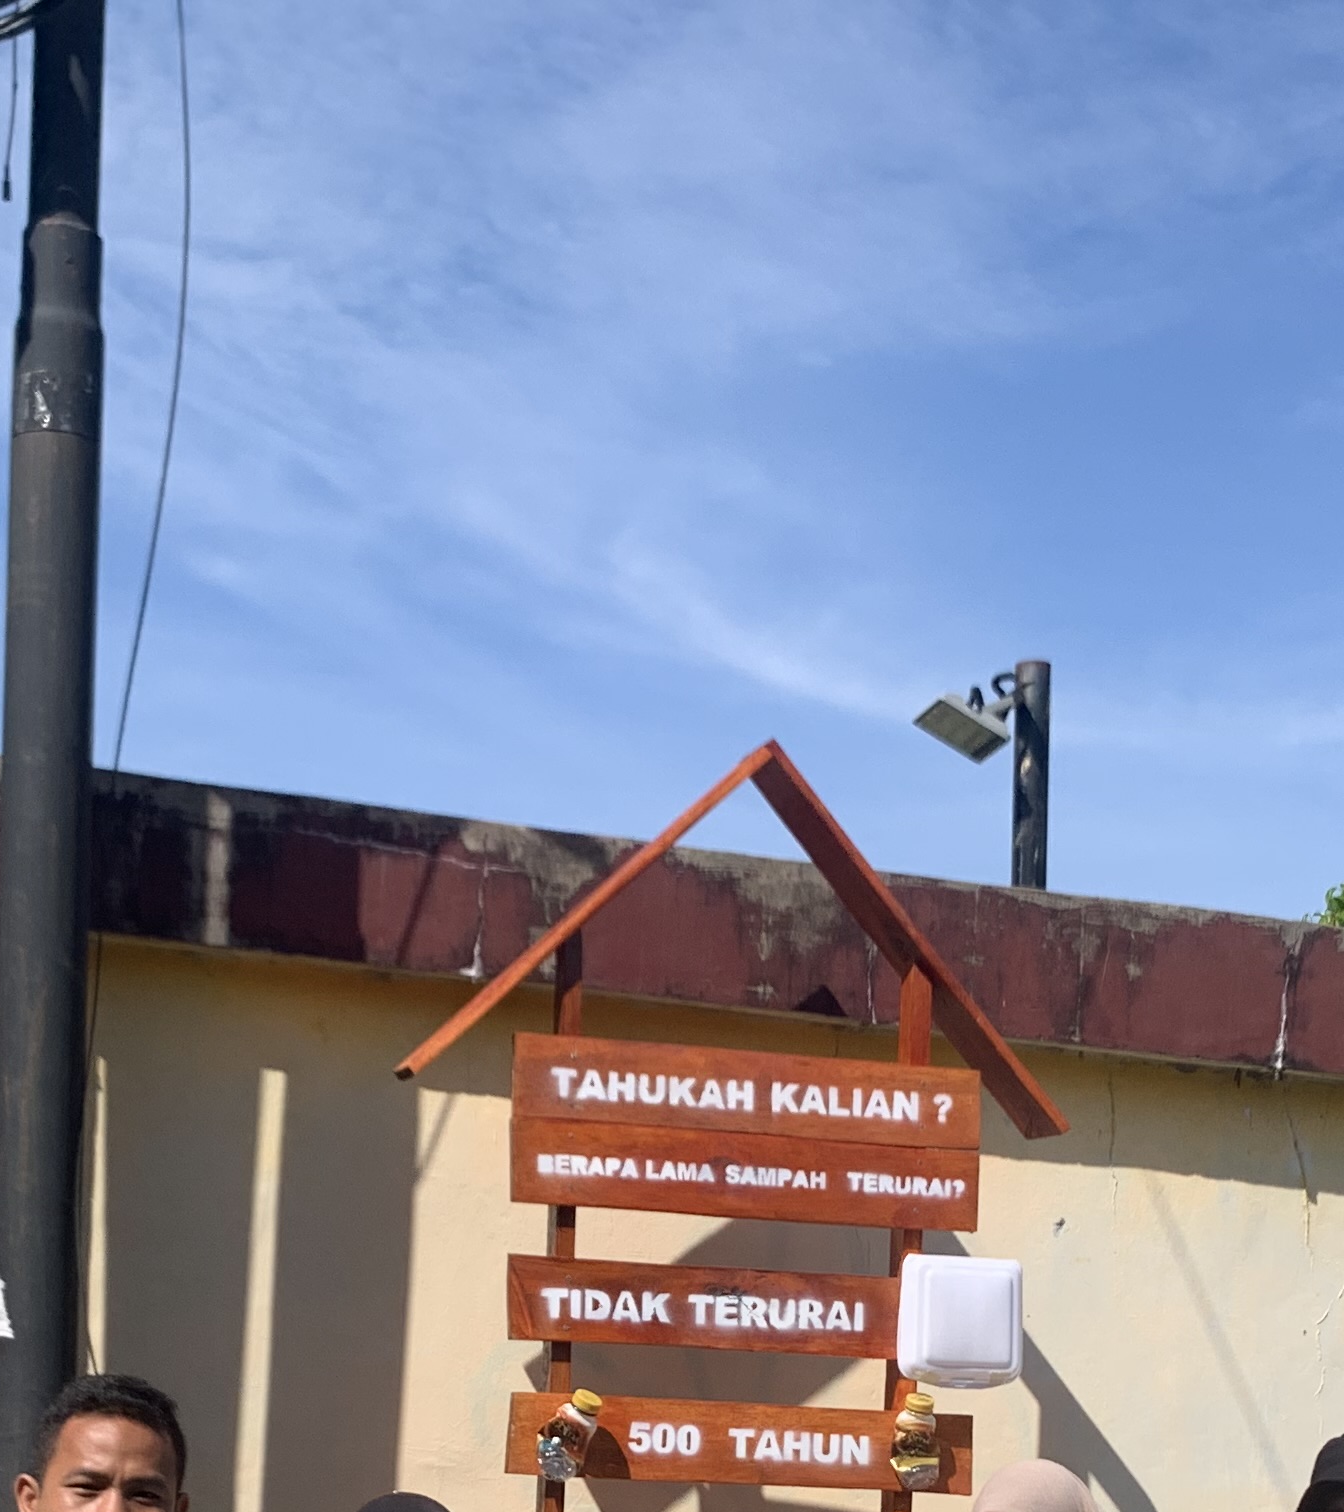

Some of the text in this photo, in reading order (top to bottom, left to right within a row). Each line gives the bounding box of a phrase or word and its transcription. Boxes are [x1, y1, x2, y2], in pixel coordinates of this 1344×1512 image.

[550, 1066, 954, 1124] TAHUKAH KALIAN ?
[536, 1153, 966, 1199] BERAPA LAMA SAMPAH TERURAI?
[541, 1286, 866, 1332] TIDAK TERURAI
[627, 1420, 701, 1457] 500
[728, 1427, 871, 1466] TAHUN
